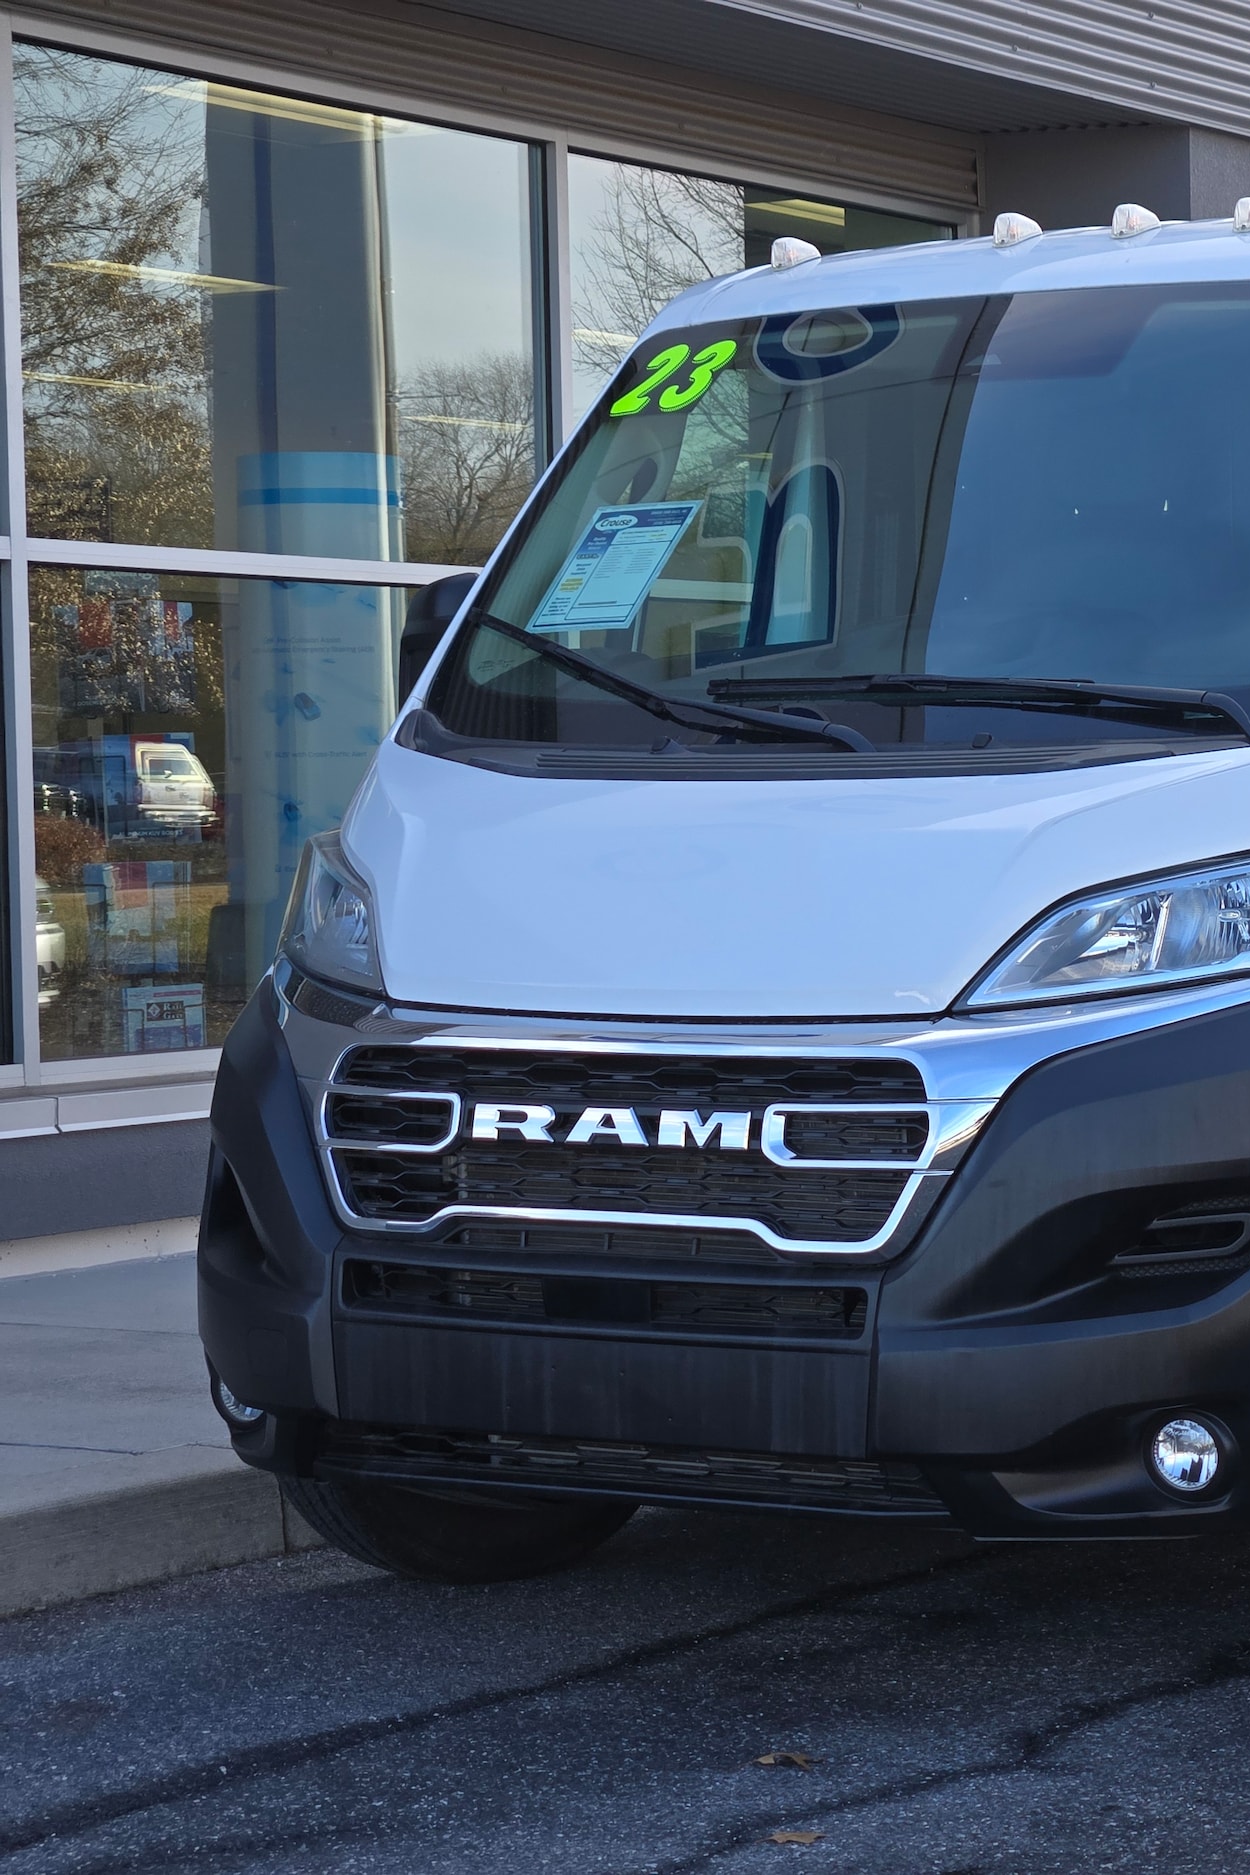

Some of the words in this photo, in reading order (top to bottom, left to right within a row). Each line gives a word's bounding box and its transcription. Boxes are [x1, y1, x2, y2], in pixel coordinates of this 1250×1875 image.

[609, 339, 738, 417] 23
[600, 518, 633, 527] Crouse
[471, 1103, 752, 1151] RAM
